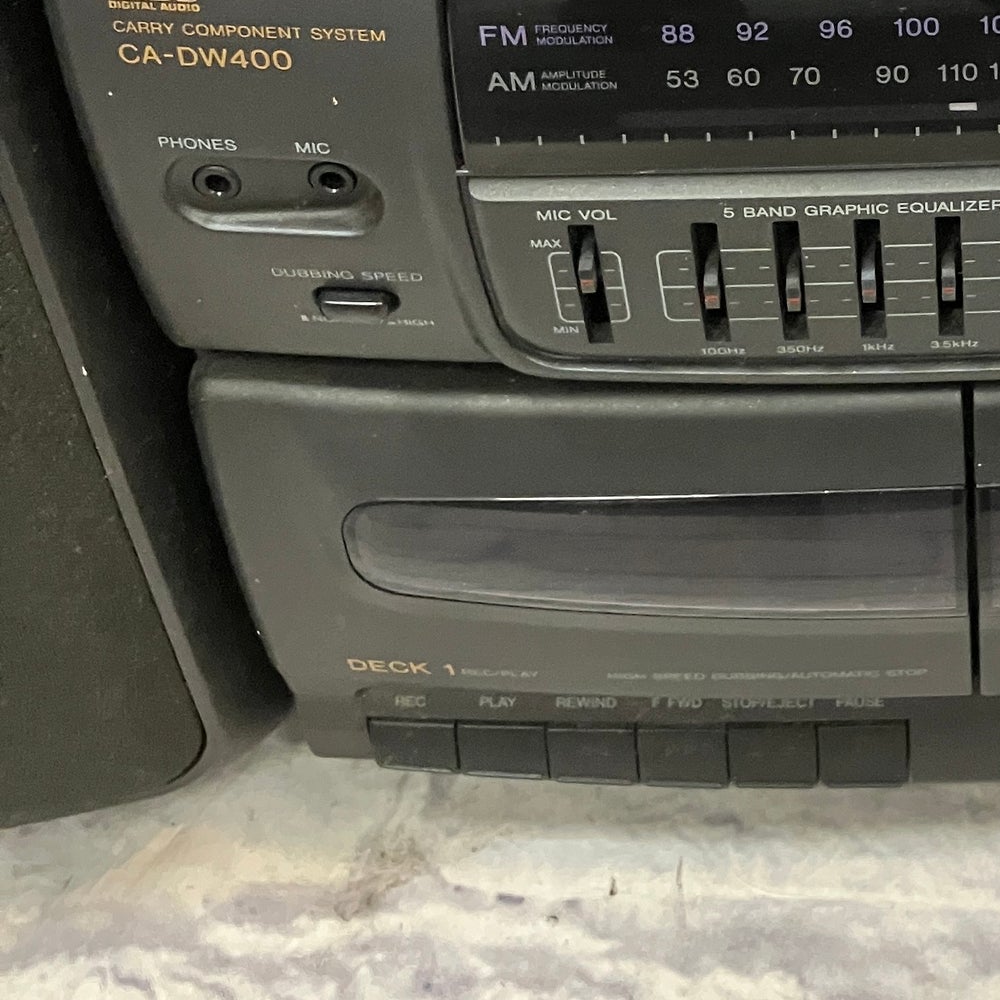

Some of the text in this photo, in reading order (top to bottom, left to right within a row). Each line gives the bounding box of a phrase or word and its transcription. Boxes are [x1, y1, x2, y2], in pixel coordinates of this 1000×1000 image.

[108, 0, 200, 13] DIGITAL AUDIO
[112, 20, 386, 42] CARRY COMPONENT SYSTEM
[534, 23, 608, 35] FREQUENCY
[661, 24, 696, 44] 88
[736, 21, 769, 42] 92
[818, 19, 853, 40] 96
[893, 17, 940, 38] 100
[478, 25, 528, 47] FM
[536, 35, 613, 46] MODULATION
[117, 43, 293, 71] CA-DW400
[487, 70, 537, 92] AM
[541, 70, 606, 81] AMPLITUDE
[666, 69, 700, 89] 53
[726, 67, 761, 87] 60
[789, 66, 821, 86] 70
[876, 64, 909, 85] 90
[937, 62, 979, 83] 110
[541, 81, 618, 92] MODULATION
[157, 136, 238, 152] PHONES
[294, 142, 331, 155] MIC
[536, 209, 618, 222] MIC VOL
[723, 207, 735, 219] 5
[743, 206, 797, 218] BAND
[804, 203, 890, 216] GRAPHIC
[530, 239, 562, 249] MAX
[271, 267, 424, 283] DUBBING SPEED
[553, 325, 580, 336] MIN
[777, 345, 824, 354] 350Hz
[862, 342, 895, 352] 1kHz
[347, 658, 432, 675] DECK
[443, 663, 455, 676] 1
[479, 696, 517, 708] PLAY
[555, 696, 618, 709] REWIND
[835, 697, 885, 708] PAUSE
